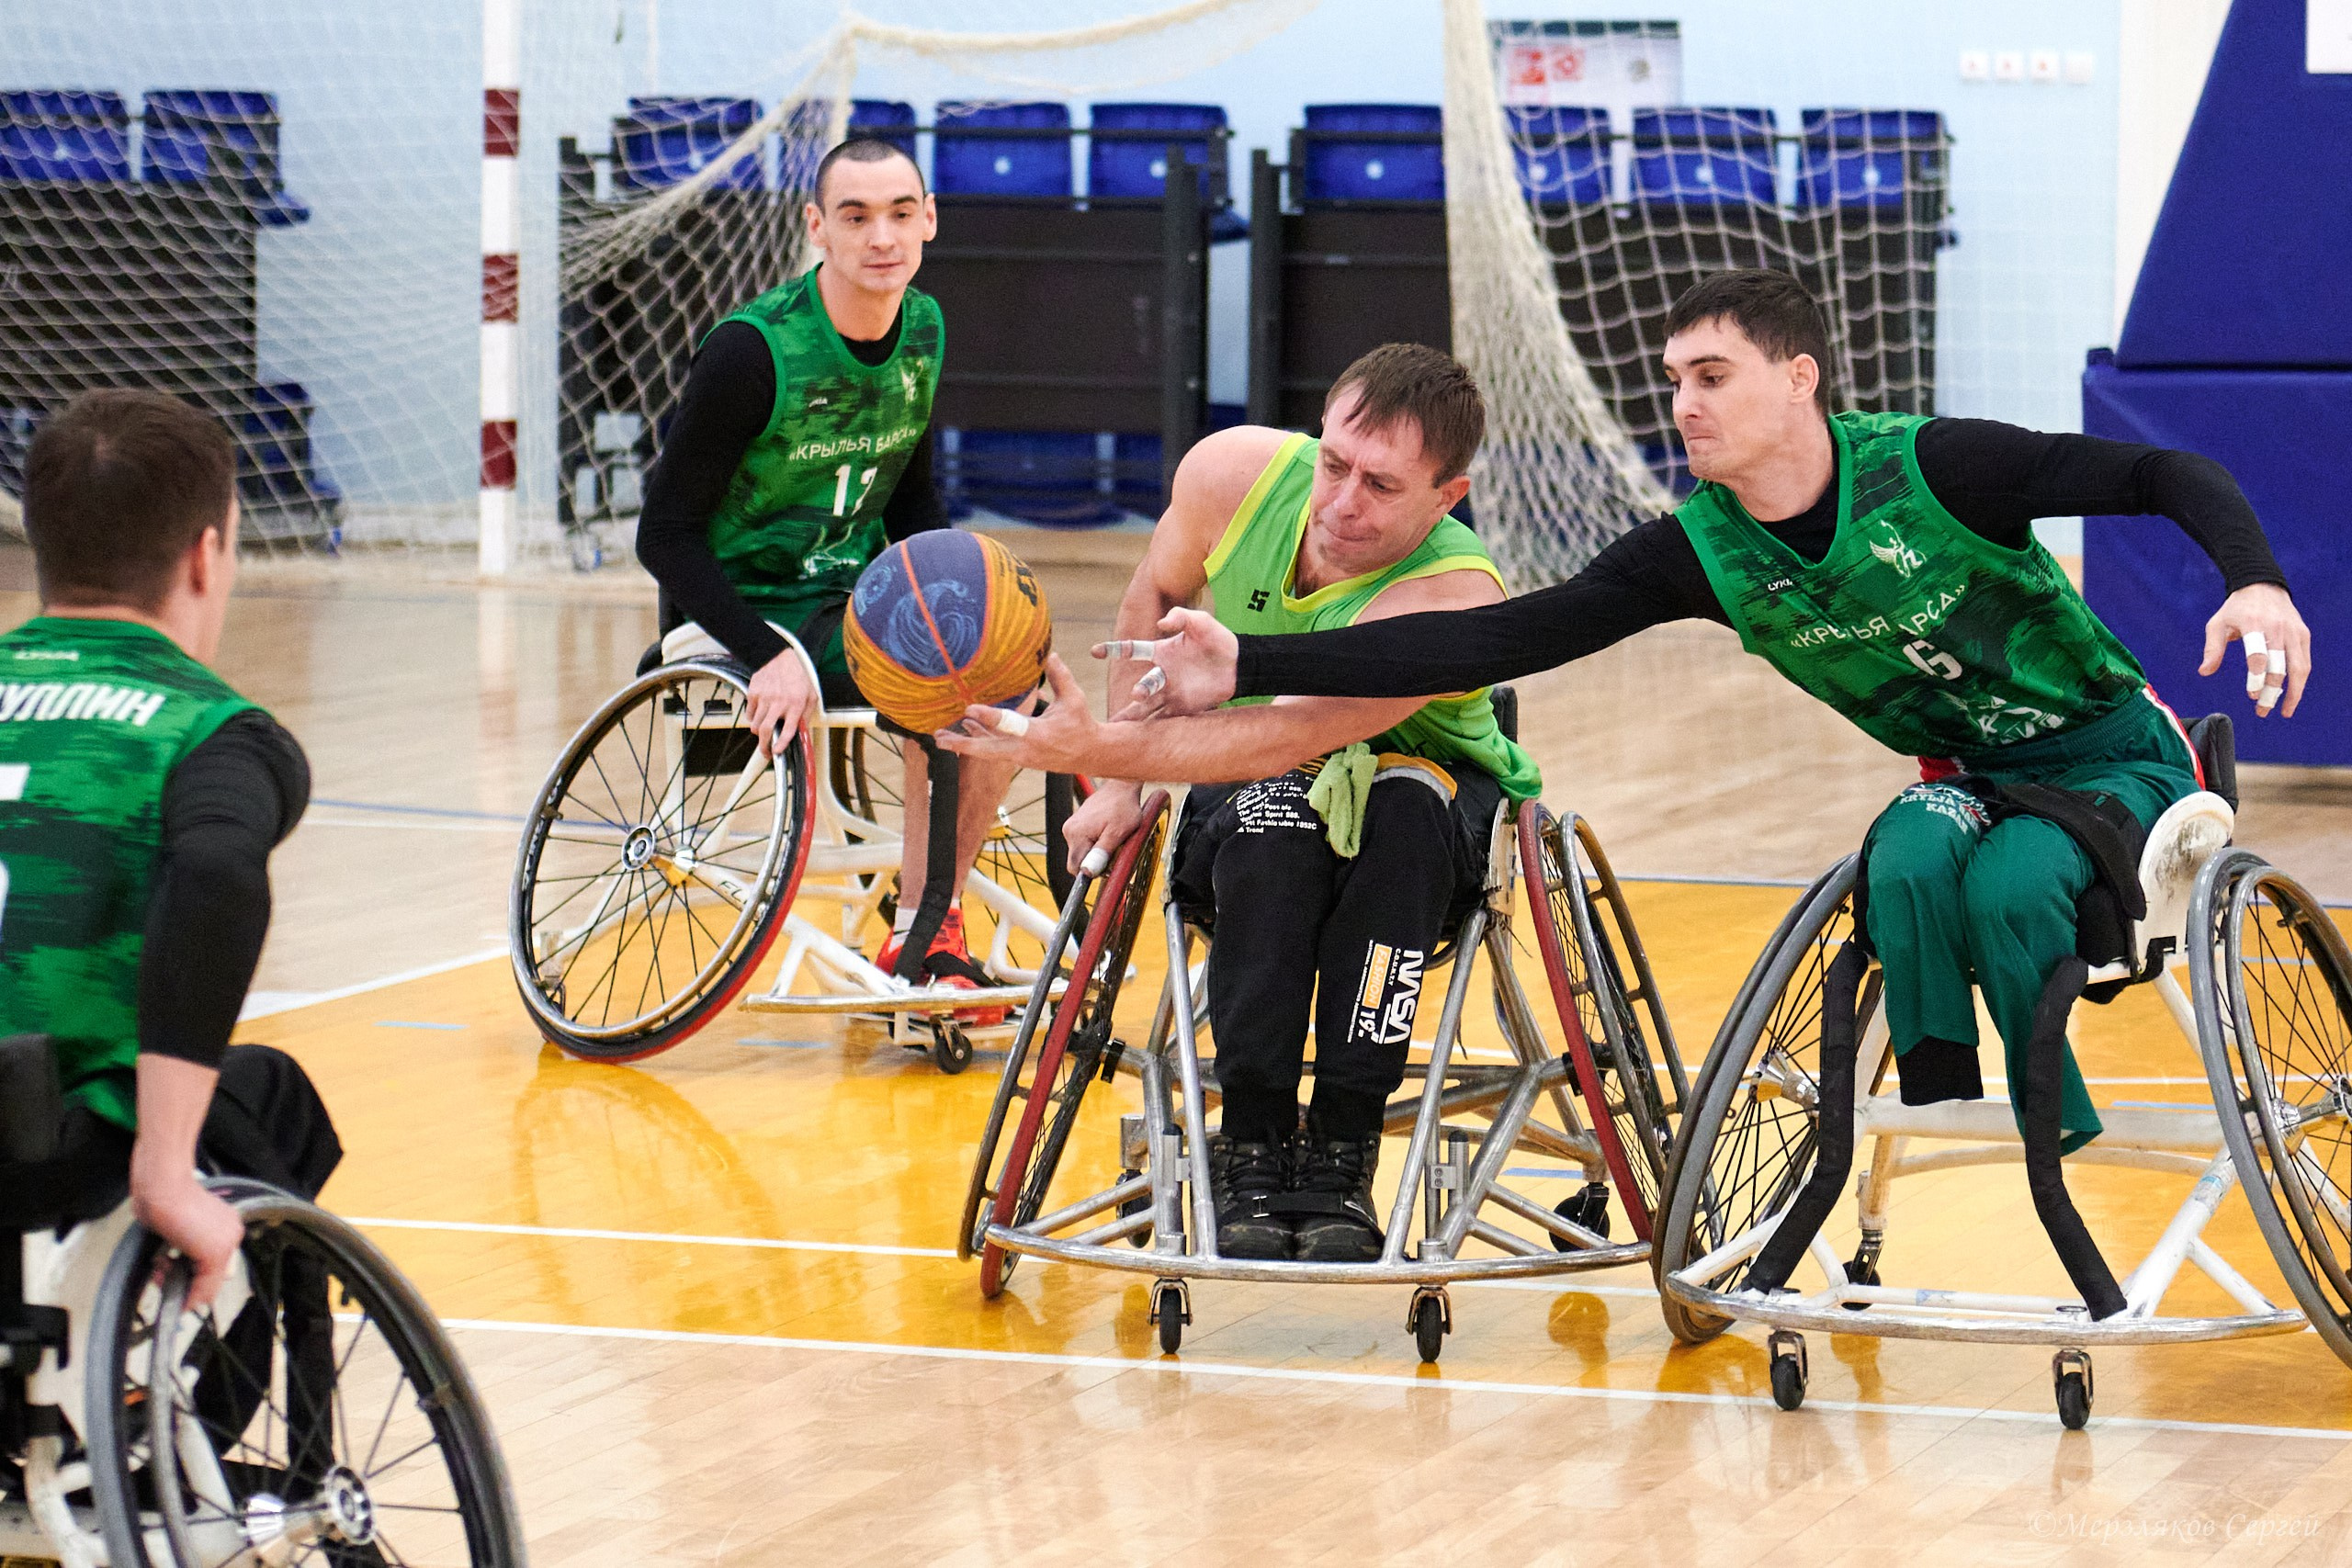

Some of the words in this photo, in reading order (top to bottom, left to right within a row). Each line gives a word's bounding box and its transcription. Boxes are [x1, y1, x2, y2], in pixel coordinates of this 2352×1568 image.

[1247, 589, 1271, 613] 5
[1902, 639, 1963, 681] 6
[1368, 948, 1388, 1004] FASHION
[1384, 949, 1424, 1044] NASA
